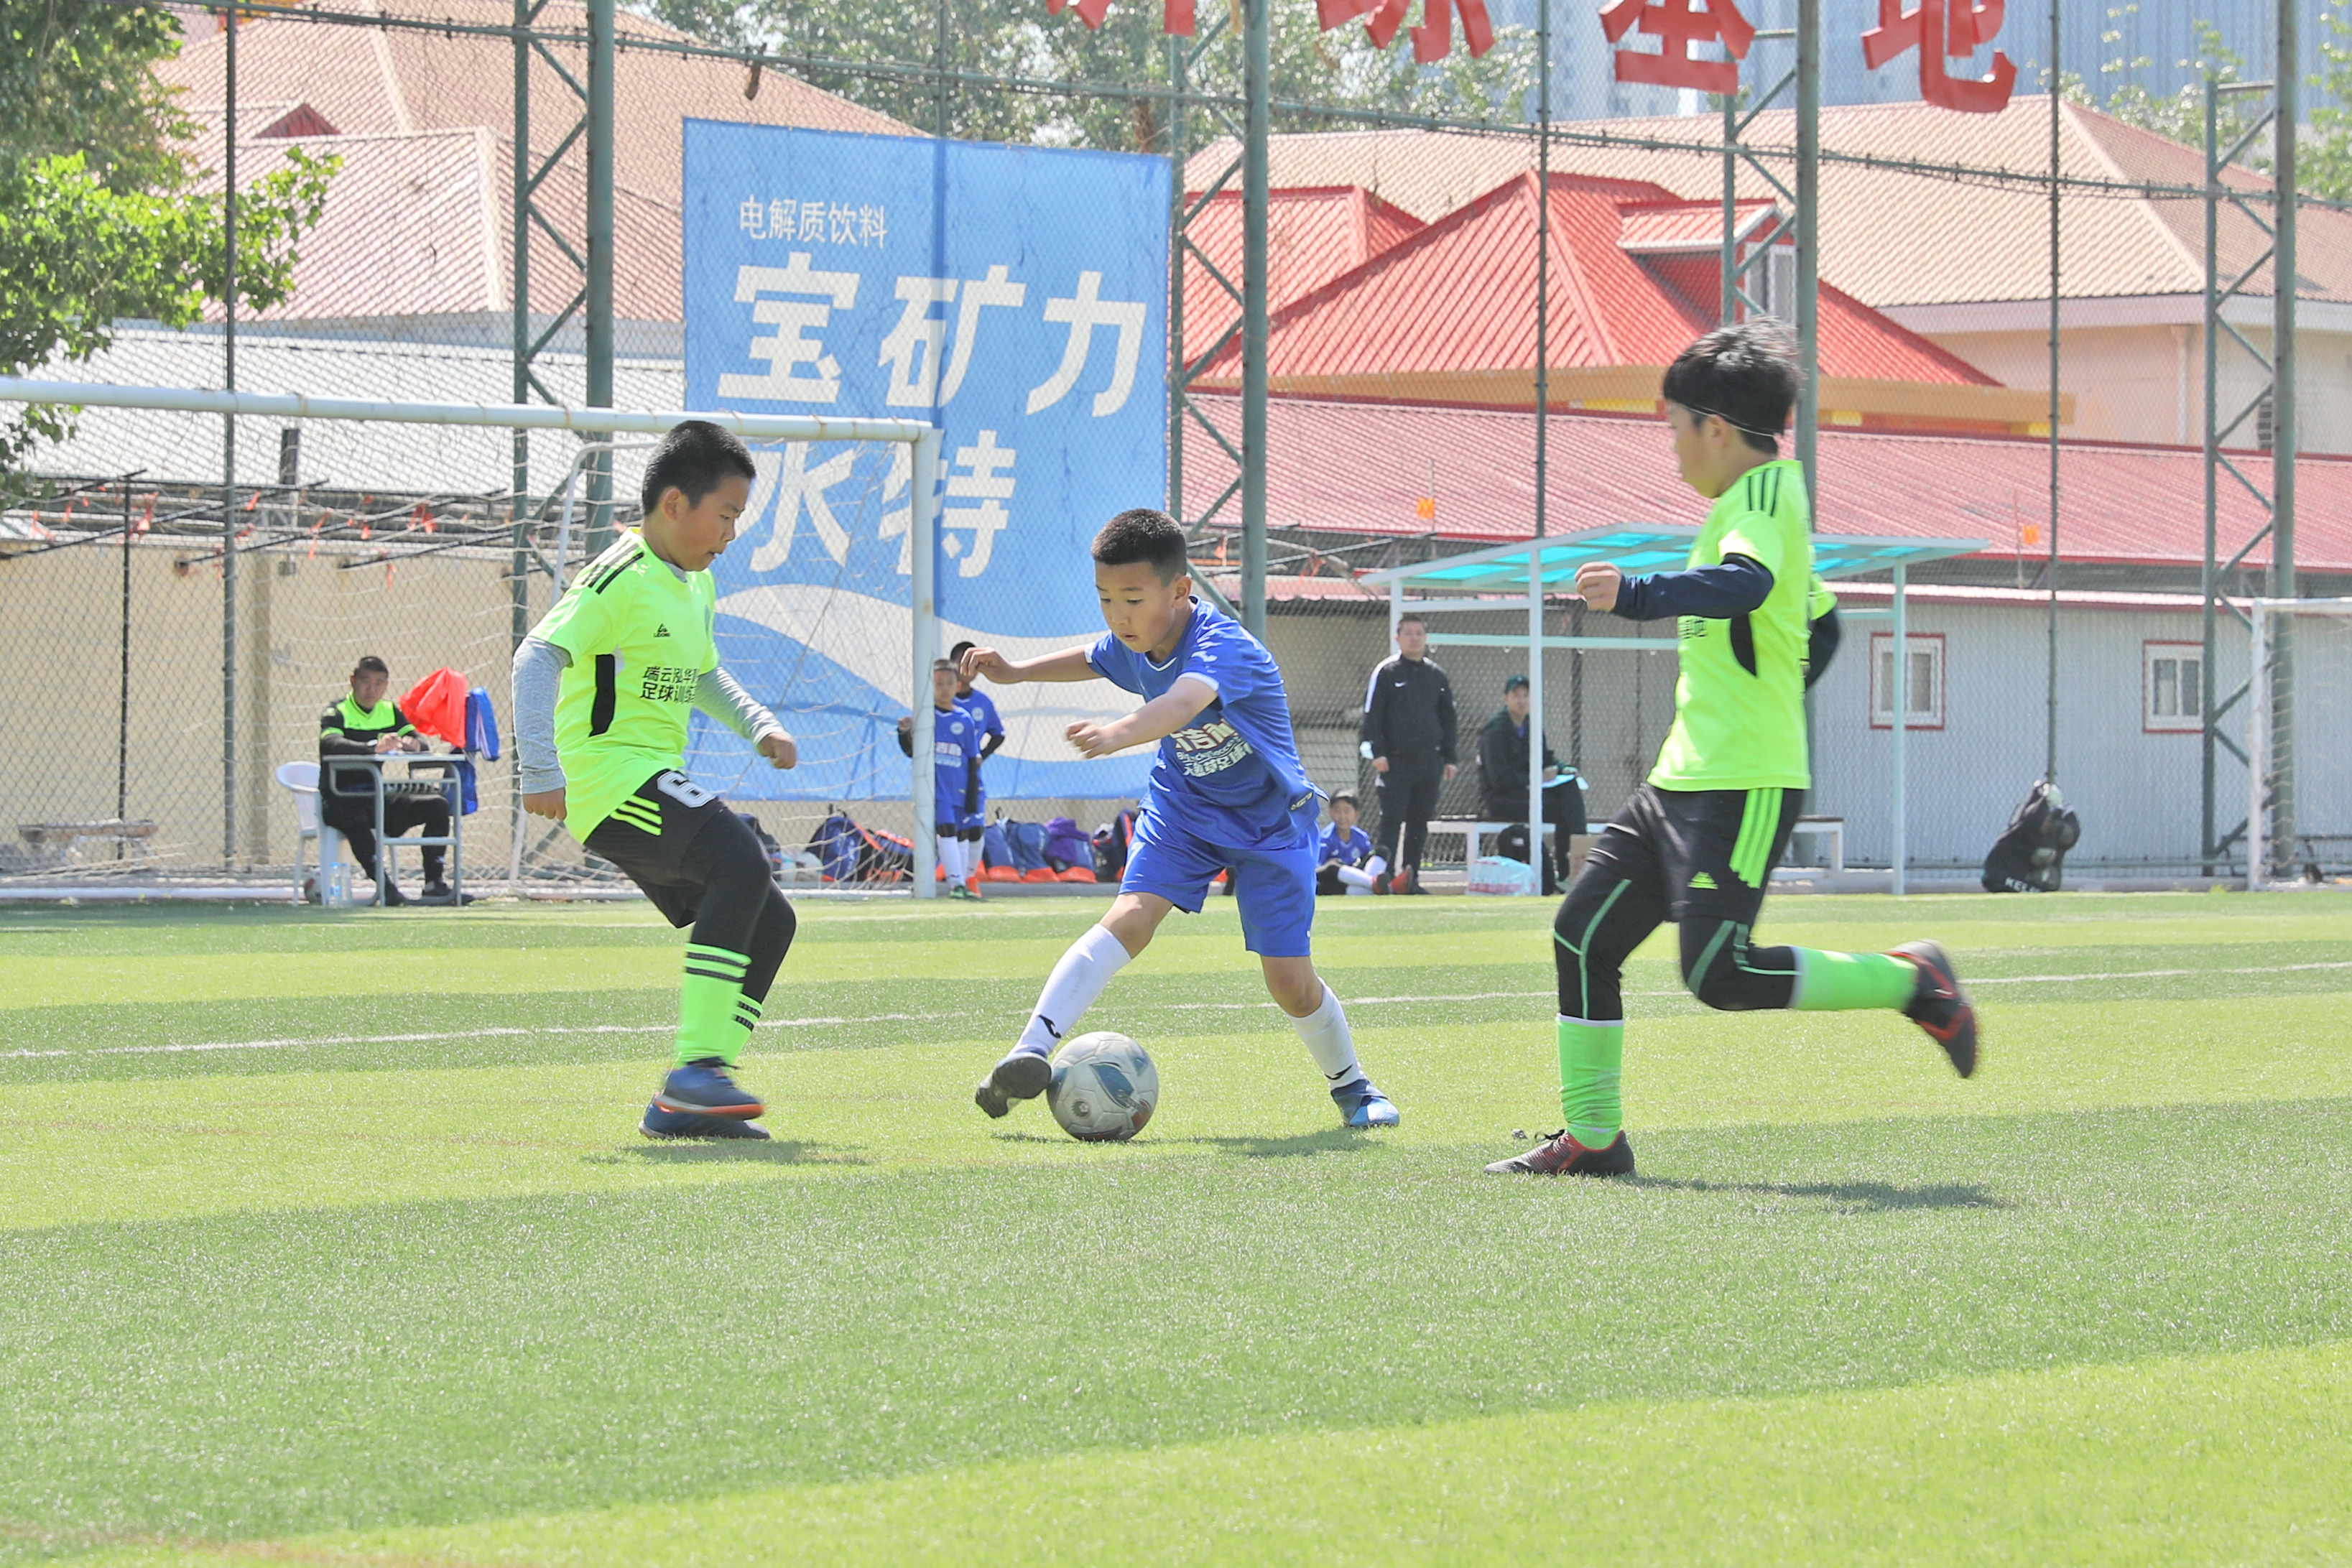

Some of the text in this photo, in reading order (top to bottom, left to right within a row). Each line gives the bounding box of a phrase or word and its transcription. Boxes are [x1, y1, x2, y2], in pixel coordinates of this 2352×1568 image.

[739, 194, 888, 249] 电解质饮料
[717, 251, 1147, 417] 宝矿力
[733, 430, 1017, 577] 水特
